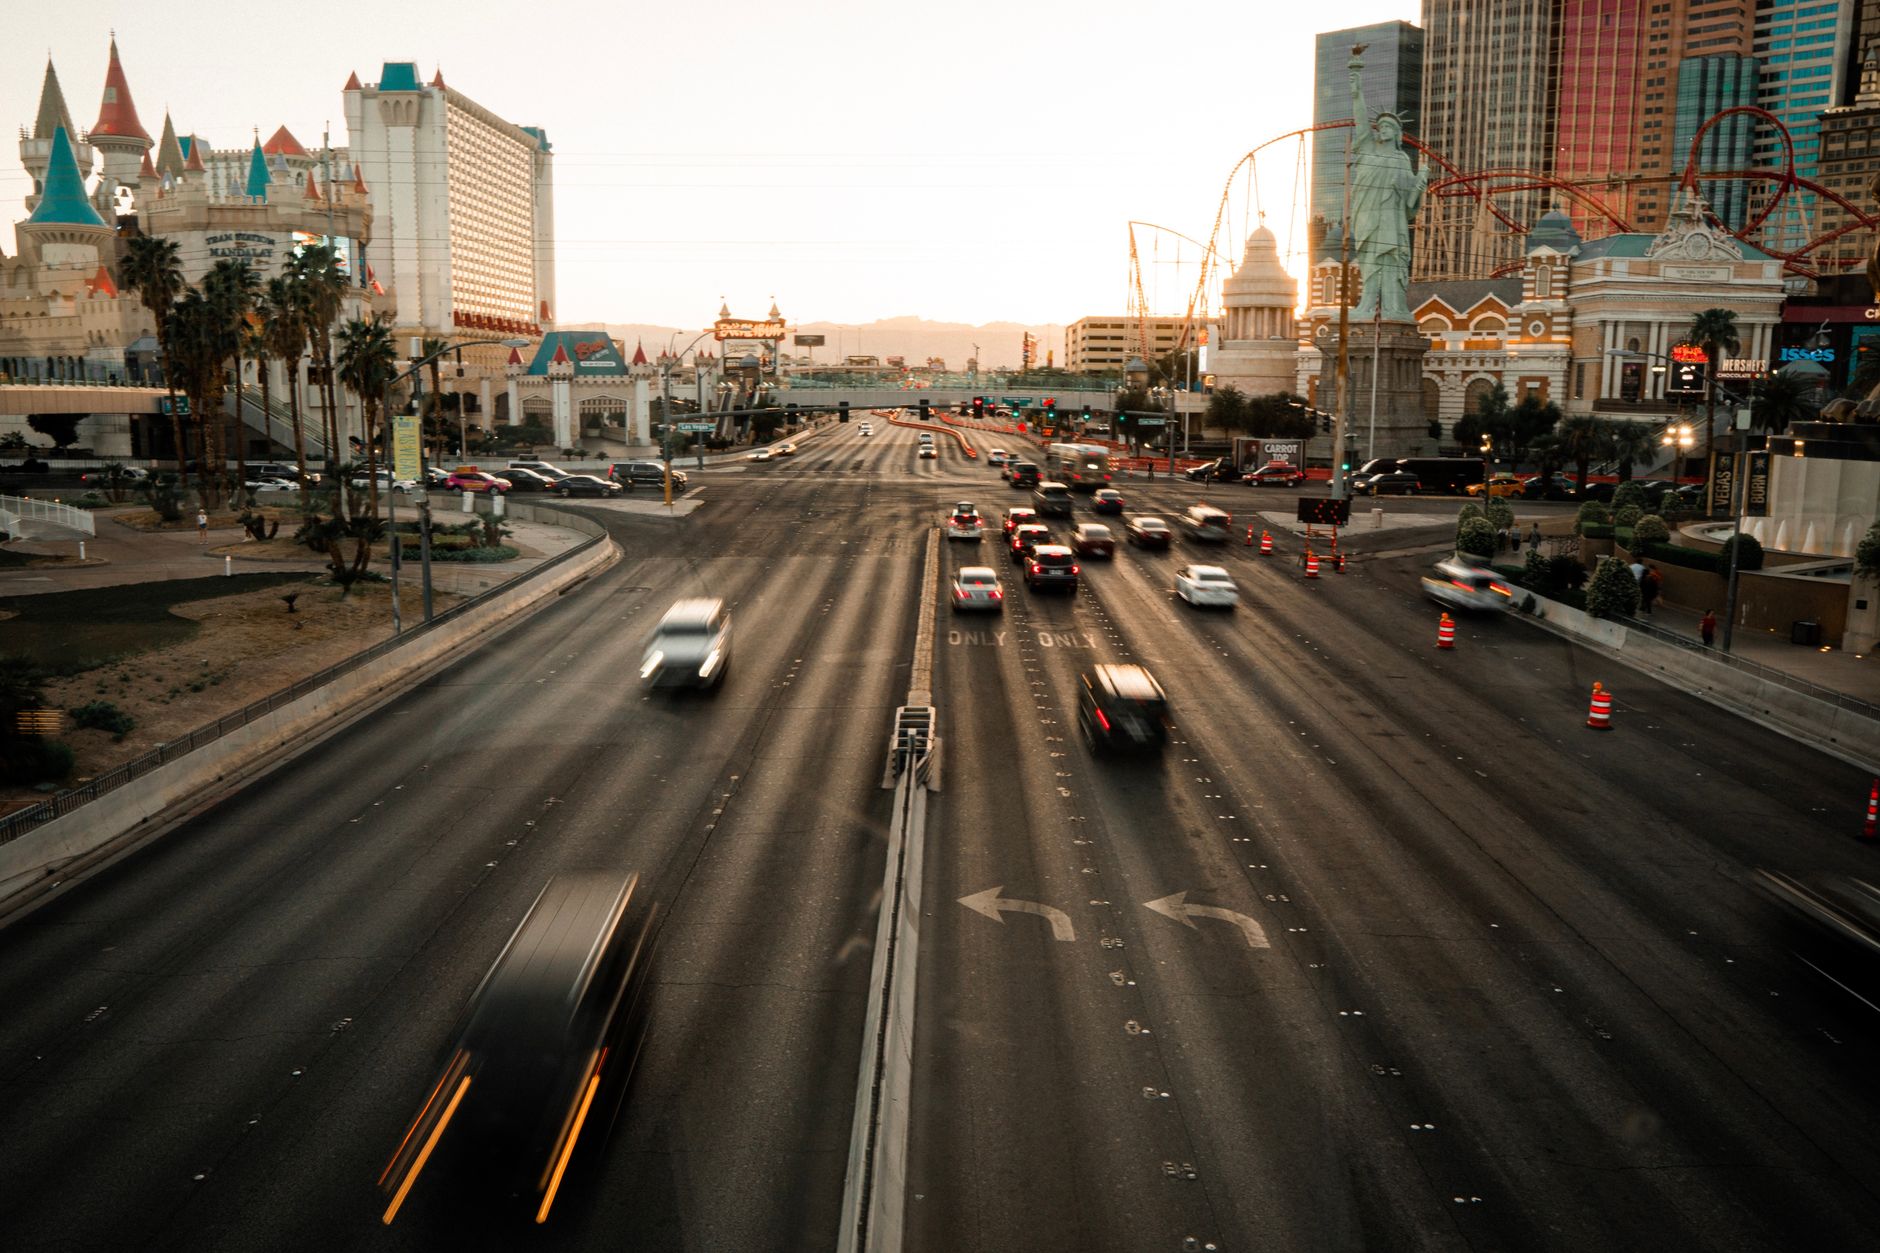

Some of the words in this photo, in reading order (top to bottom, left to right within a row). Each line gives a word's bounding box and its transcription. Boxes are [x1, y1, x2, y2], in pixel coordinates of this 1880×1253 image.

[209, 247, 272, 257] MANDALAY
[1264, 444, 1298, 454] CARROT
[1273, 453, 1289, 461] TOP
[1714, 471, 1732, 506] VEGAS
[1750, 474, 1767, 504] BORN
[949, 630, 1007, 647] ONLY
[1037, 631, 1097, 649] ONLY
